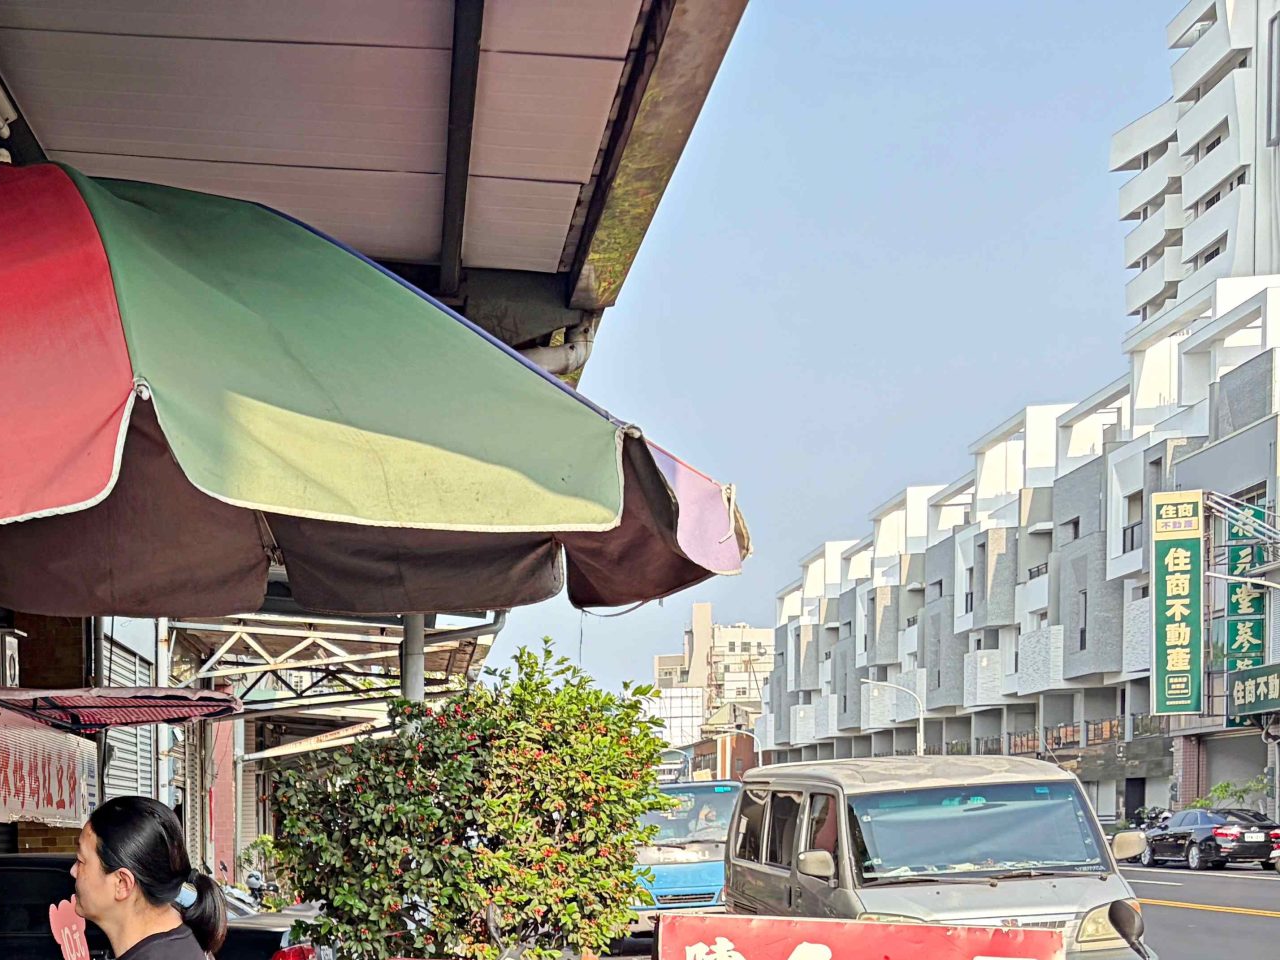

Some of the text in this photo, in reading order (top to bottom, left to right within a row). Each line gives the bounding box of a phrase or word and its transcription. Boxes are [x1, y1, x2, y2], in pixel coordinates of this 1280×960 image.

[1160, 504, 1194, 519] 住商
[1165, 547, 1192, 672] 住商不動產
